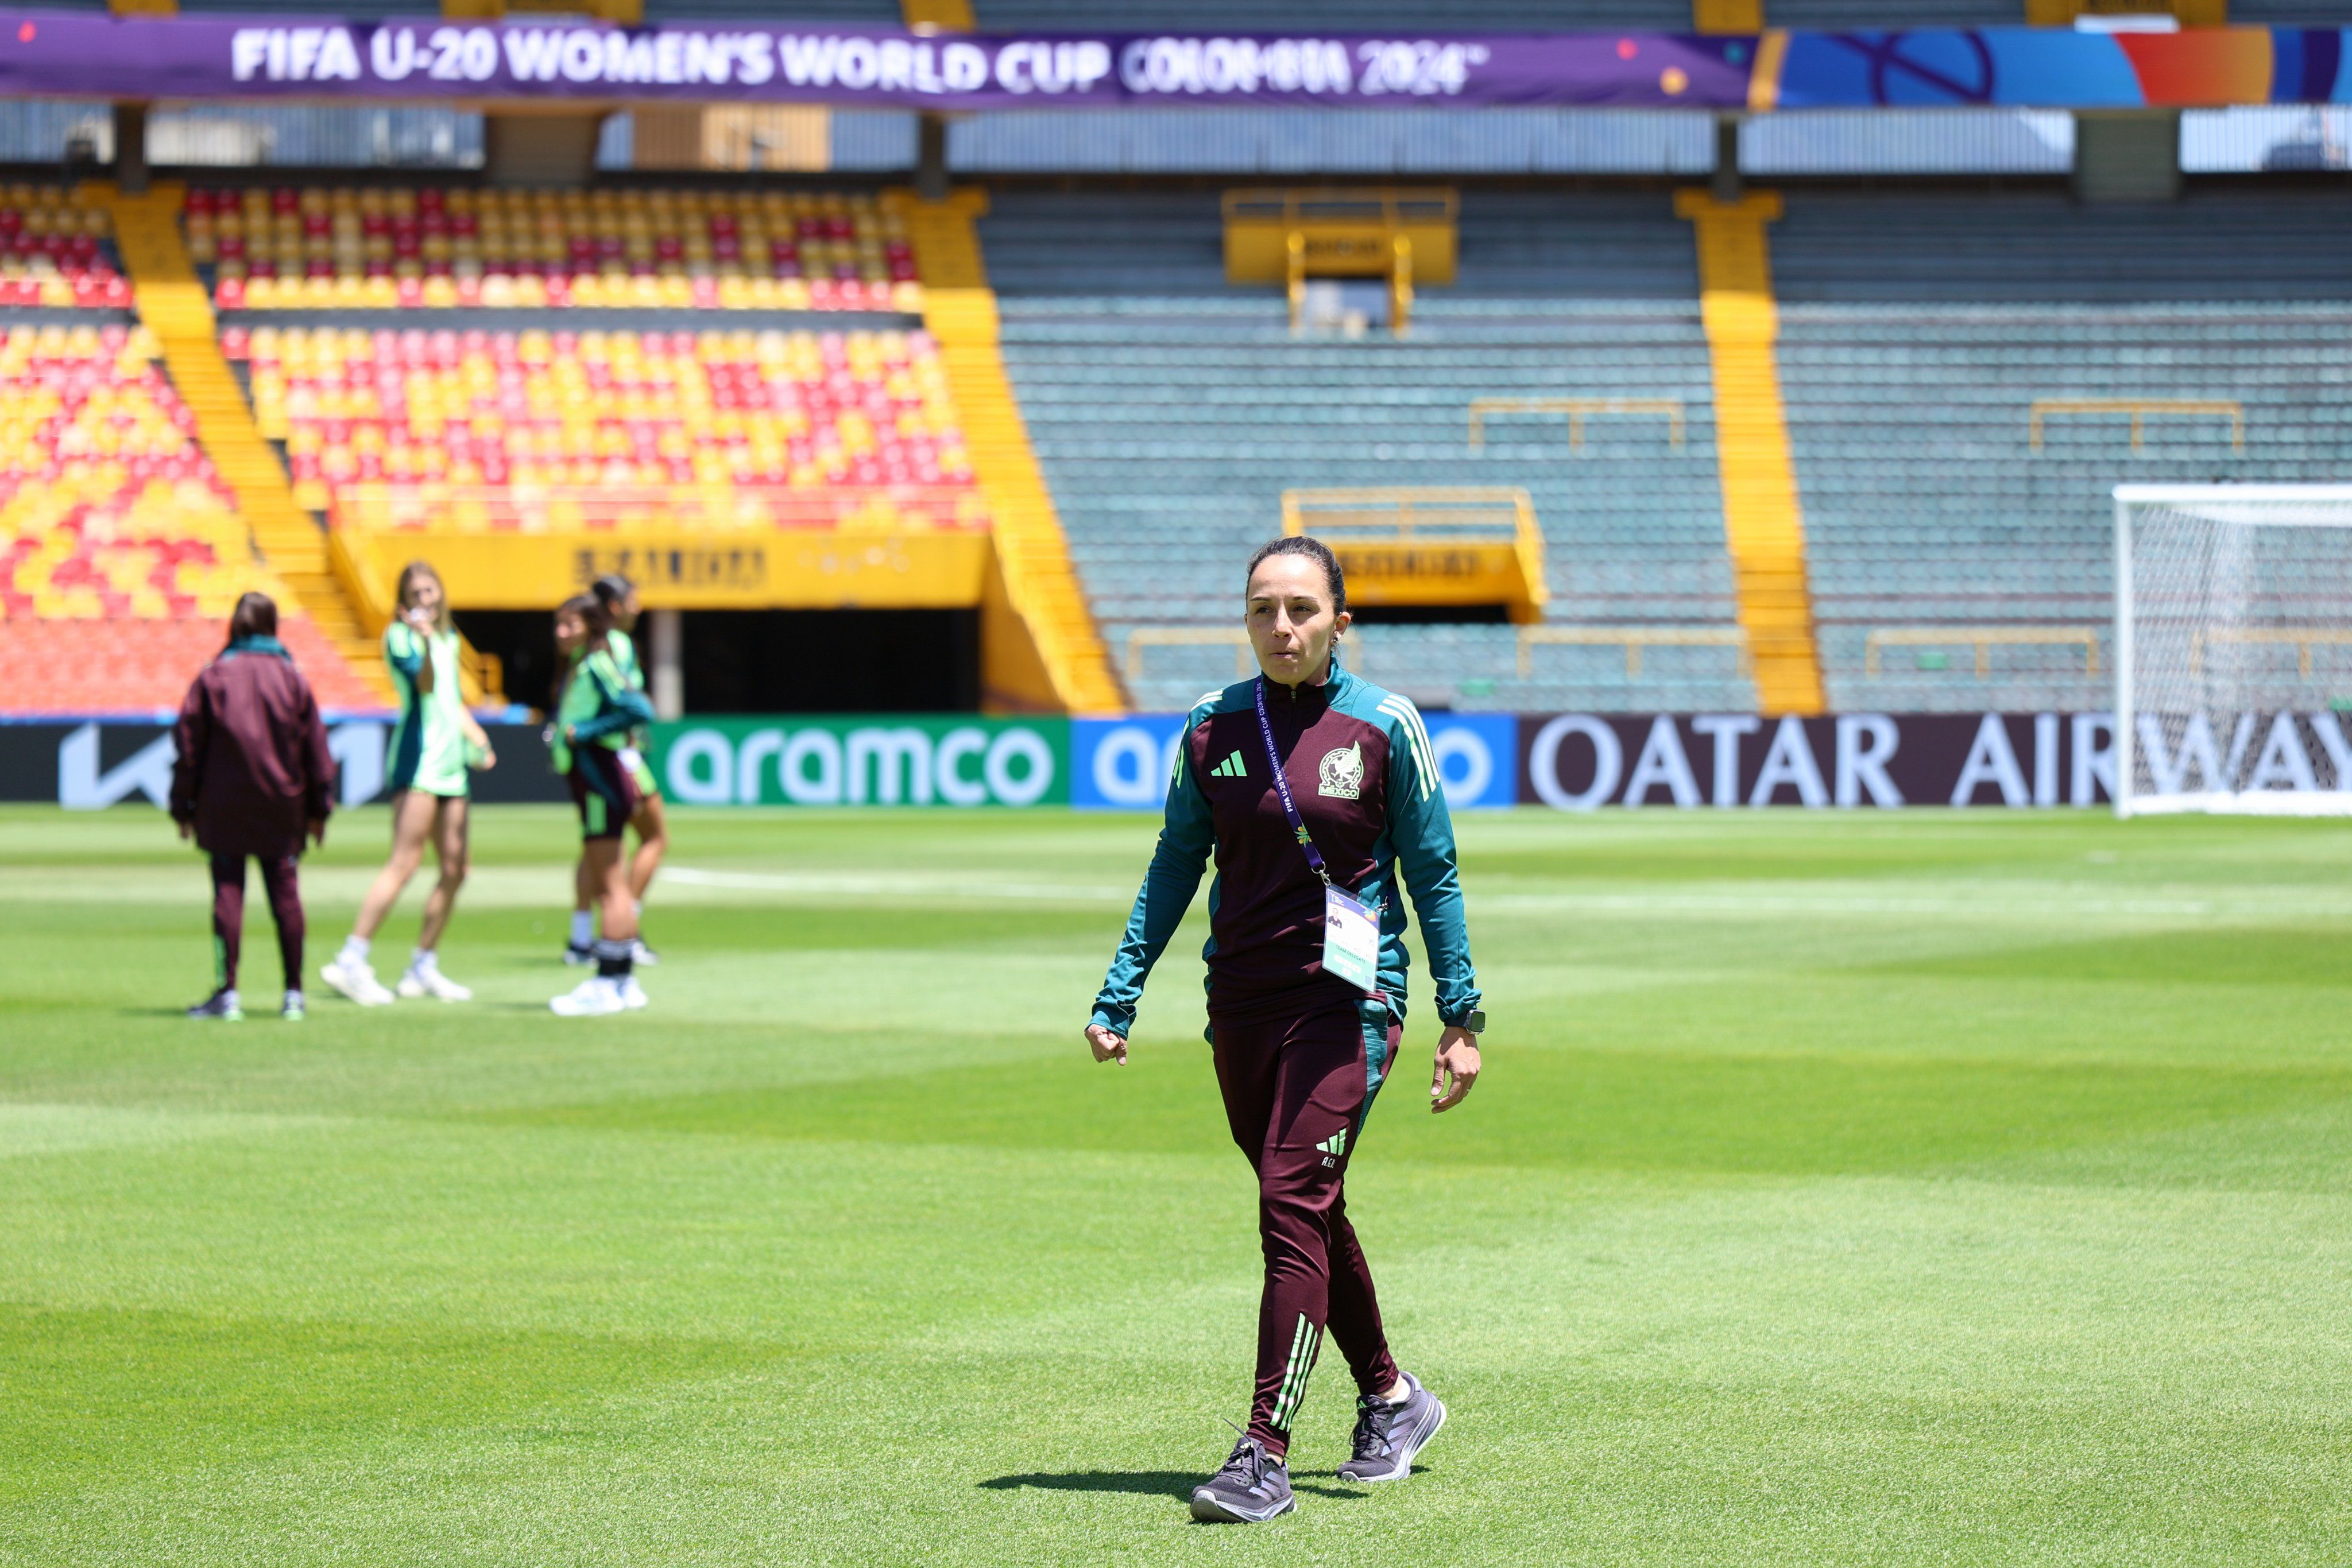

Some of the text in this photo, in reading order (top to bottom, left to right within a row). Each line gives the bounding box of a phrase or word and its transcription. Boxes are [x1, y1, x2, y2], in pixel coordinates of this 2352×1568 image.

[231, 26, 362, 82] FIFA
[370, 26, 498, 82] U-20
[503, 29, 774, 85] WOMEN'S
[780, 33, 988, 94] WORLD
[995, 41, 1111, 94] CUP
[1264, 730, 1274, 752] WORLD
[666, 727, 1054, 806] aramco
[1270, 752, 1283, 781] WOMEN'S
[1529, 713, 1906, 811] QATAR
[1279, 781, 1288, 796] U-20
[1321, 785, 1357, 797] MÉXICO
[1284, 796, 1293, 812] FIFA
[1336, 944, 1347, 954] TEAM
[1347, 951, 1365, 964] DELEGATE
